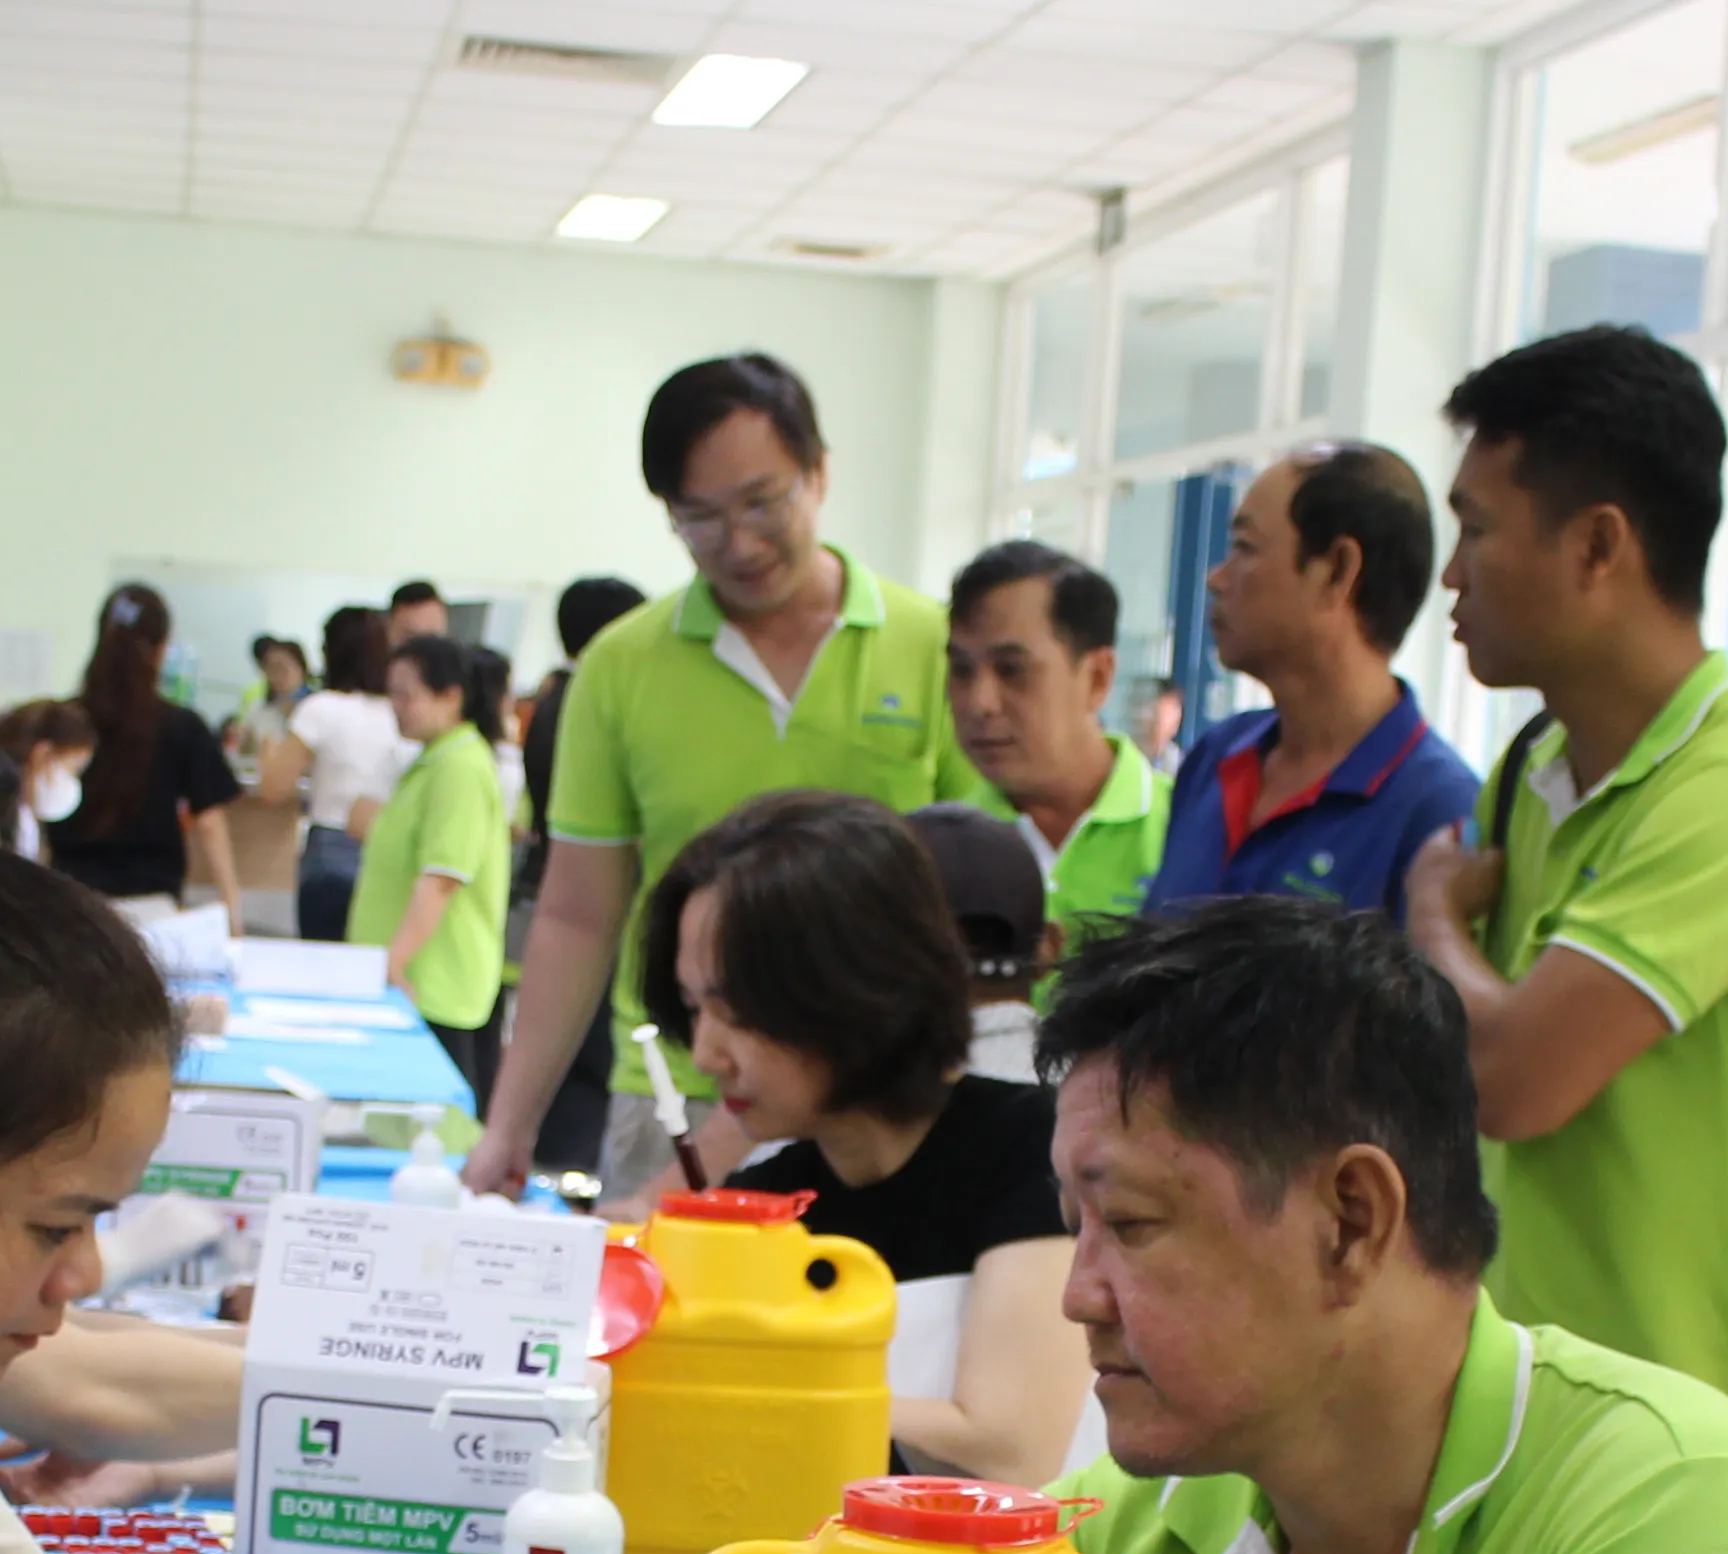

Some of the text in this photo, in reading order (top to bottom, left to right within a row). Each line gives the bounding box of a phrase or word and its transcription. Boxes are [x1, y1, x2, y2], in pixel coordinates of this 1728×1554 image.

[353, 1261, 366, 1281] 5
[318, 1336, 485, 1371] MPV SYRINGE
[279, 1495, 335, 1520] BƠM
[342, 1498, 397, 1526] TIÊM
[402, 1507, 455, 1532] MPV
